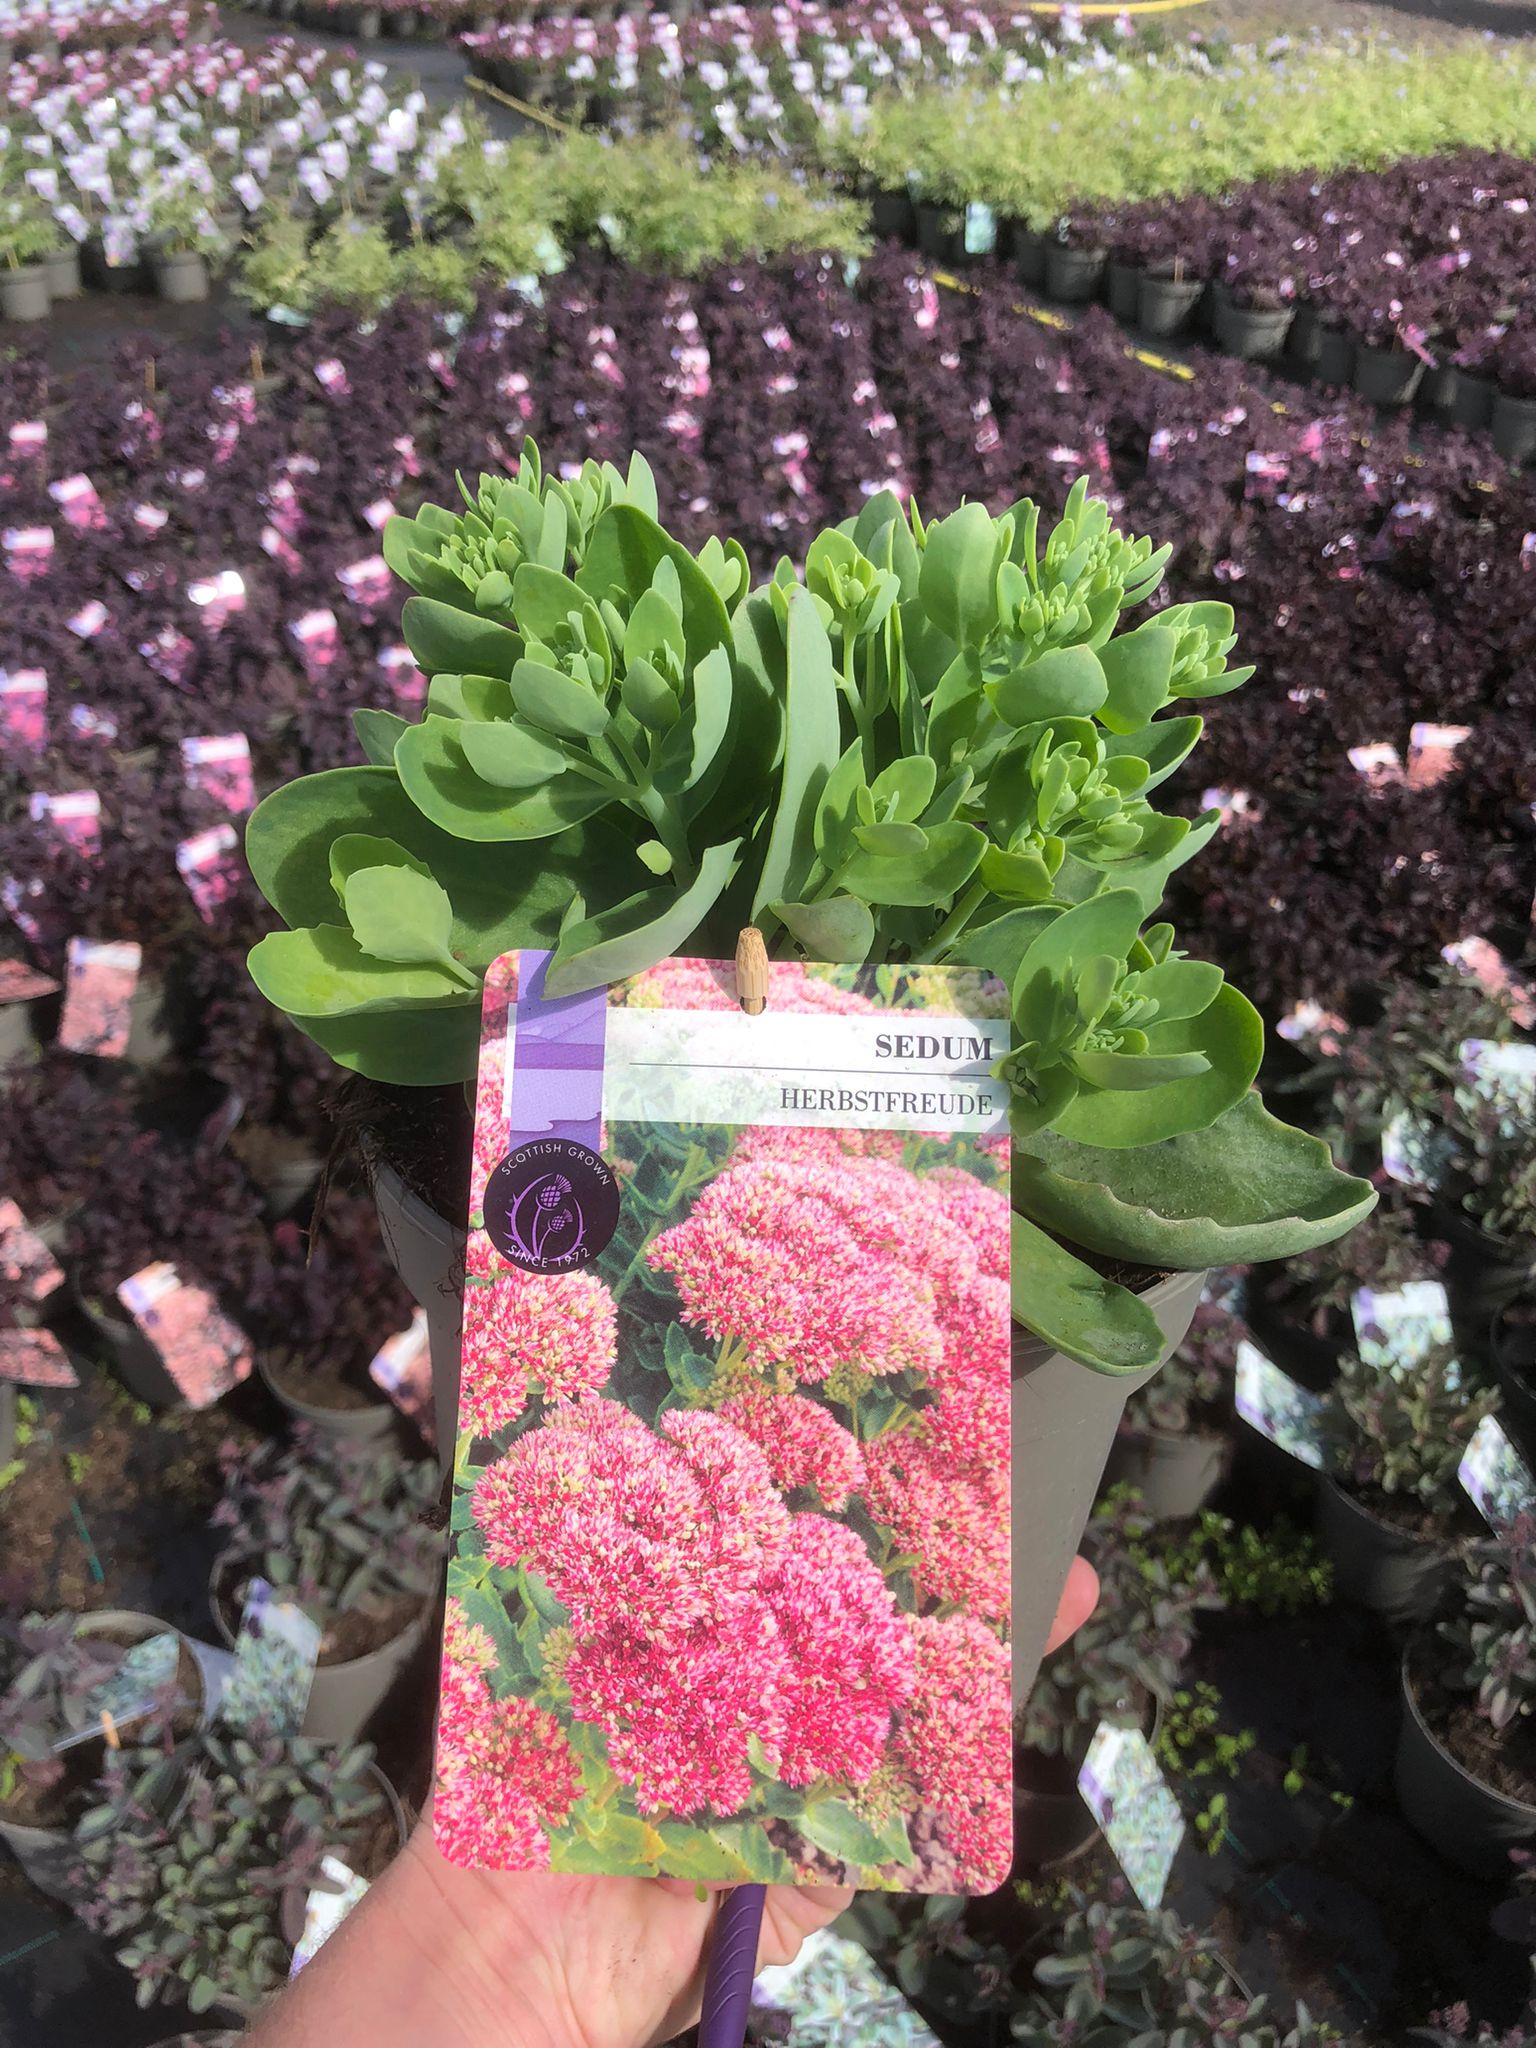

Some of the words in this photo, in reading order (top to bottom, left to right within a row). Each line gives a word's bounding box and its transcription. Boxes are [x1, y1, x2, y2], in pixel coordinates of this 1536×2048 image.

[875, 1034, 993, 1061] SEDUM
[780, 1088, 993, 1116] HERBSTFREUDE
[501, 1143, 562, 1176] SCOTTISH
[567, 1146, 611, 1187] GROWN
[507, 1244, 549, 1268] SINCE
[557, 1247, 591, 1268] 1972
